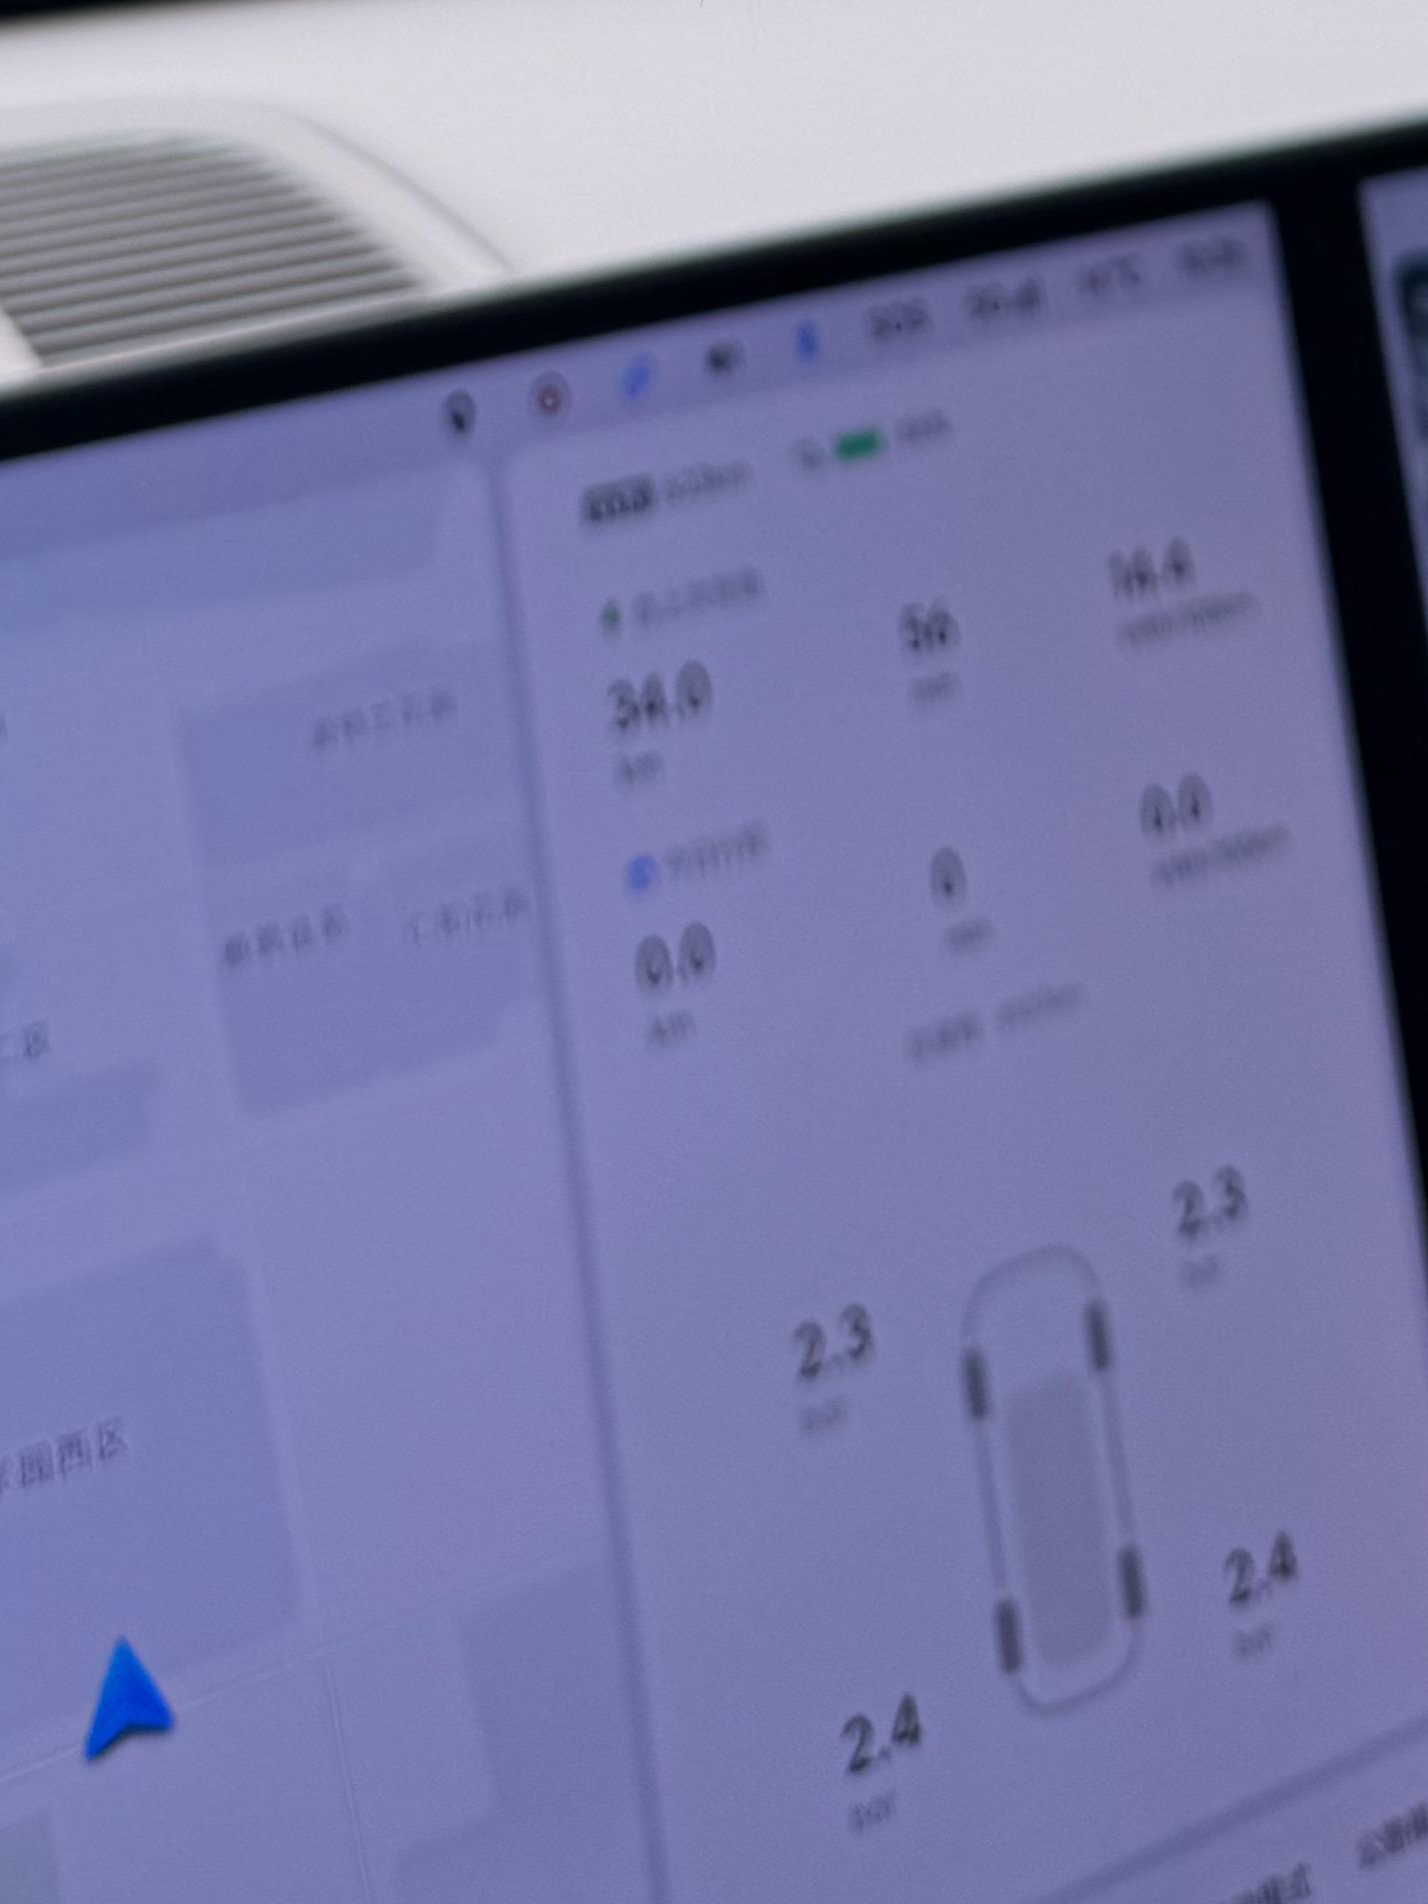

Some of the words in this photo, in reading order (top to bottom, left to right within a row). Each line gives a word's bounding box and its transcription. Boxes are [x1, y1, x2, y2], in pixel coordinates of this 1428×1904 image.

[1139, 772, 1212, 837] 0.0
[929, 846, 967, 904] 0
[634, 921, 717, 993] 0.0
[1173, 1164, 1251, 1243] 2.3
[792, 1303, 876, 1384] 2.3
[1224, 1530, 1300, 1611] 2.4
[840, 1691, 924, 1778] 2.4
